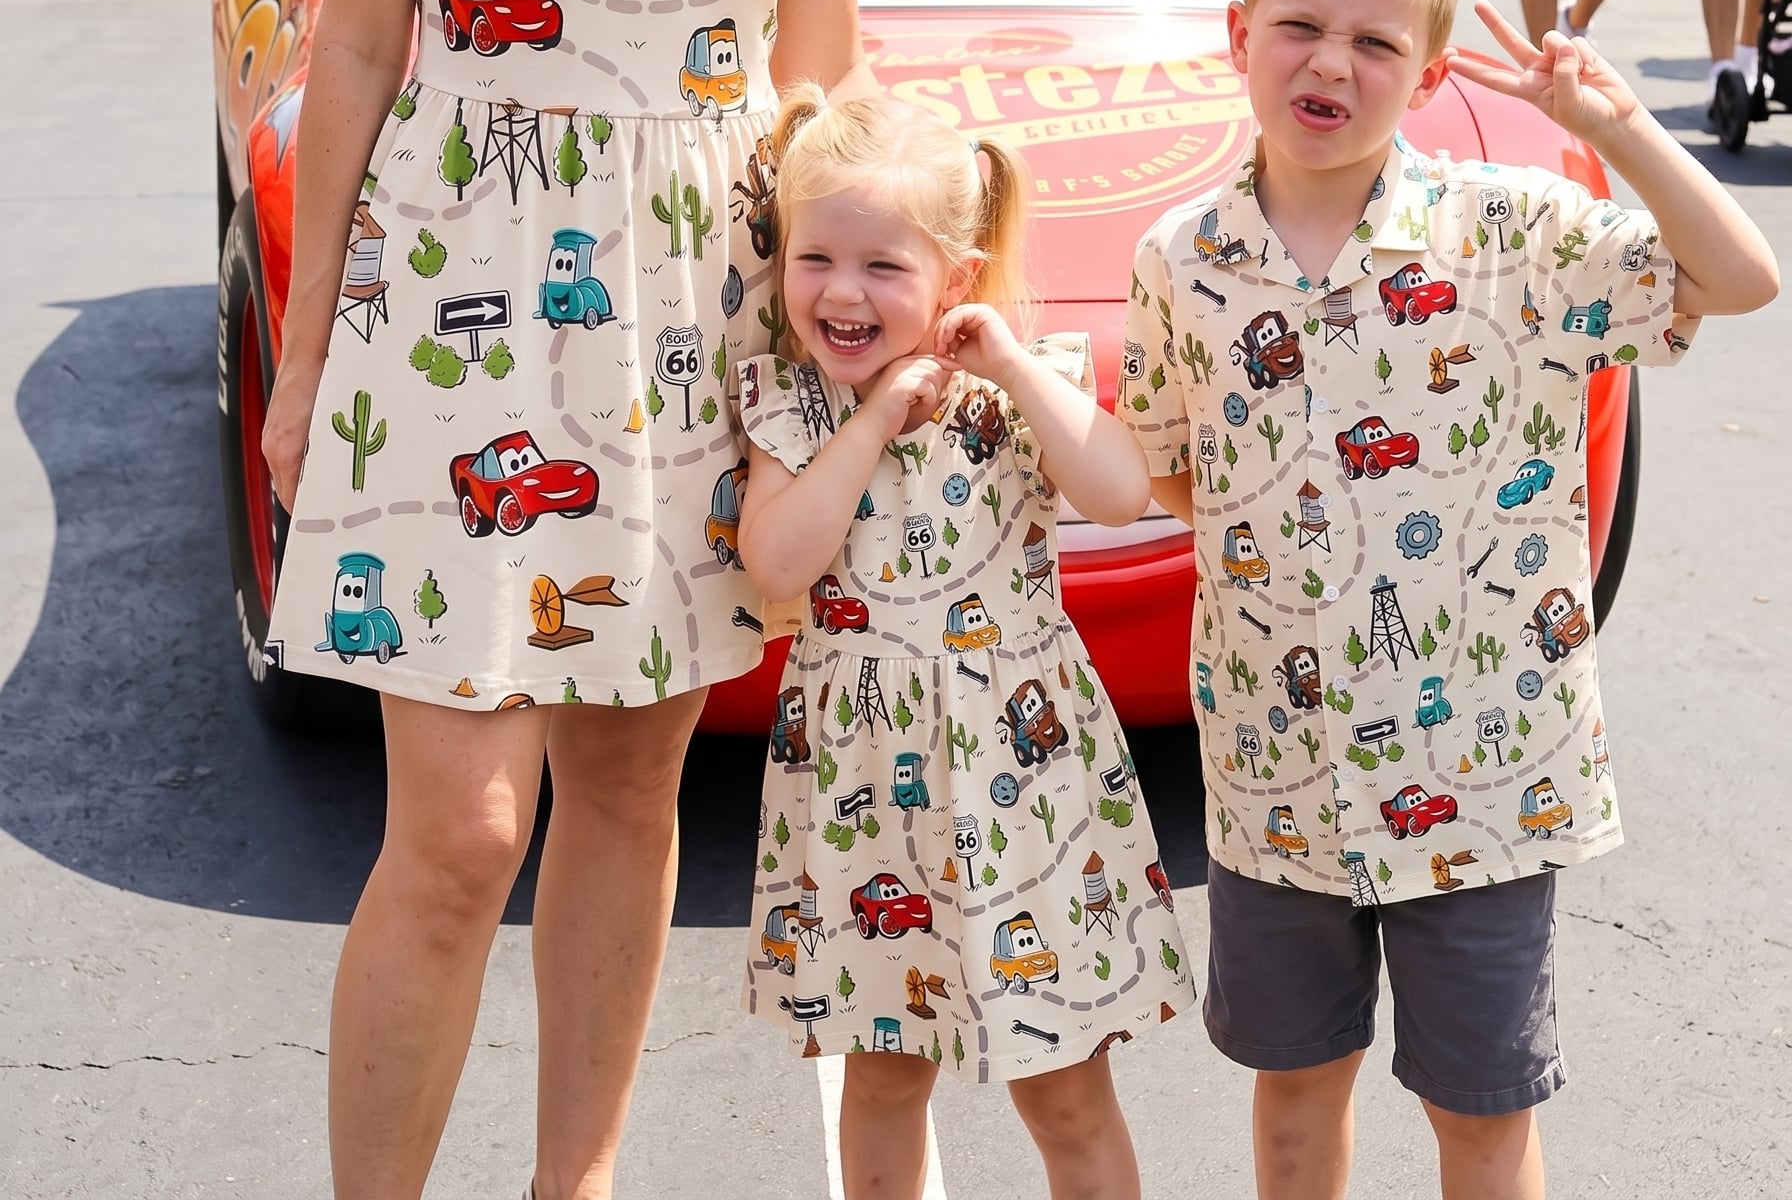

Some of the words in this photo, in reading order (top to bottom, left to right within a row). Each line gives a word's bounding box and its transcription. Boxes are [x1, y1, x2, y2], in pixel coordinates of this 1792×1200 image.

[1486, 200, 1507, 218] 66
[666, 348, 698, 375] 66
[1200, 440, 1215, 457] 66
[907, 528, 931, 546] 66
[1484, 720, 1504, 737] 66
[1241, 736, 1257, 750] 66
[955, 831, 977, 851] 66
